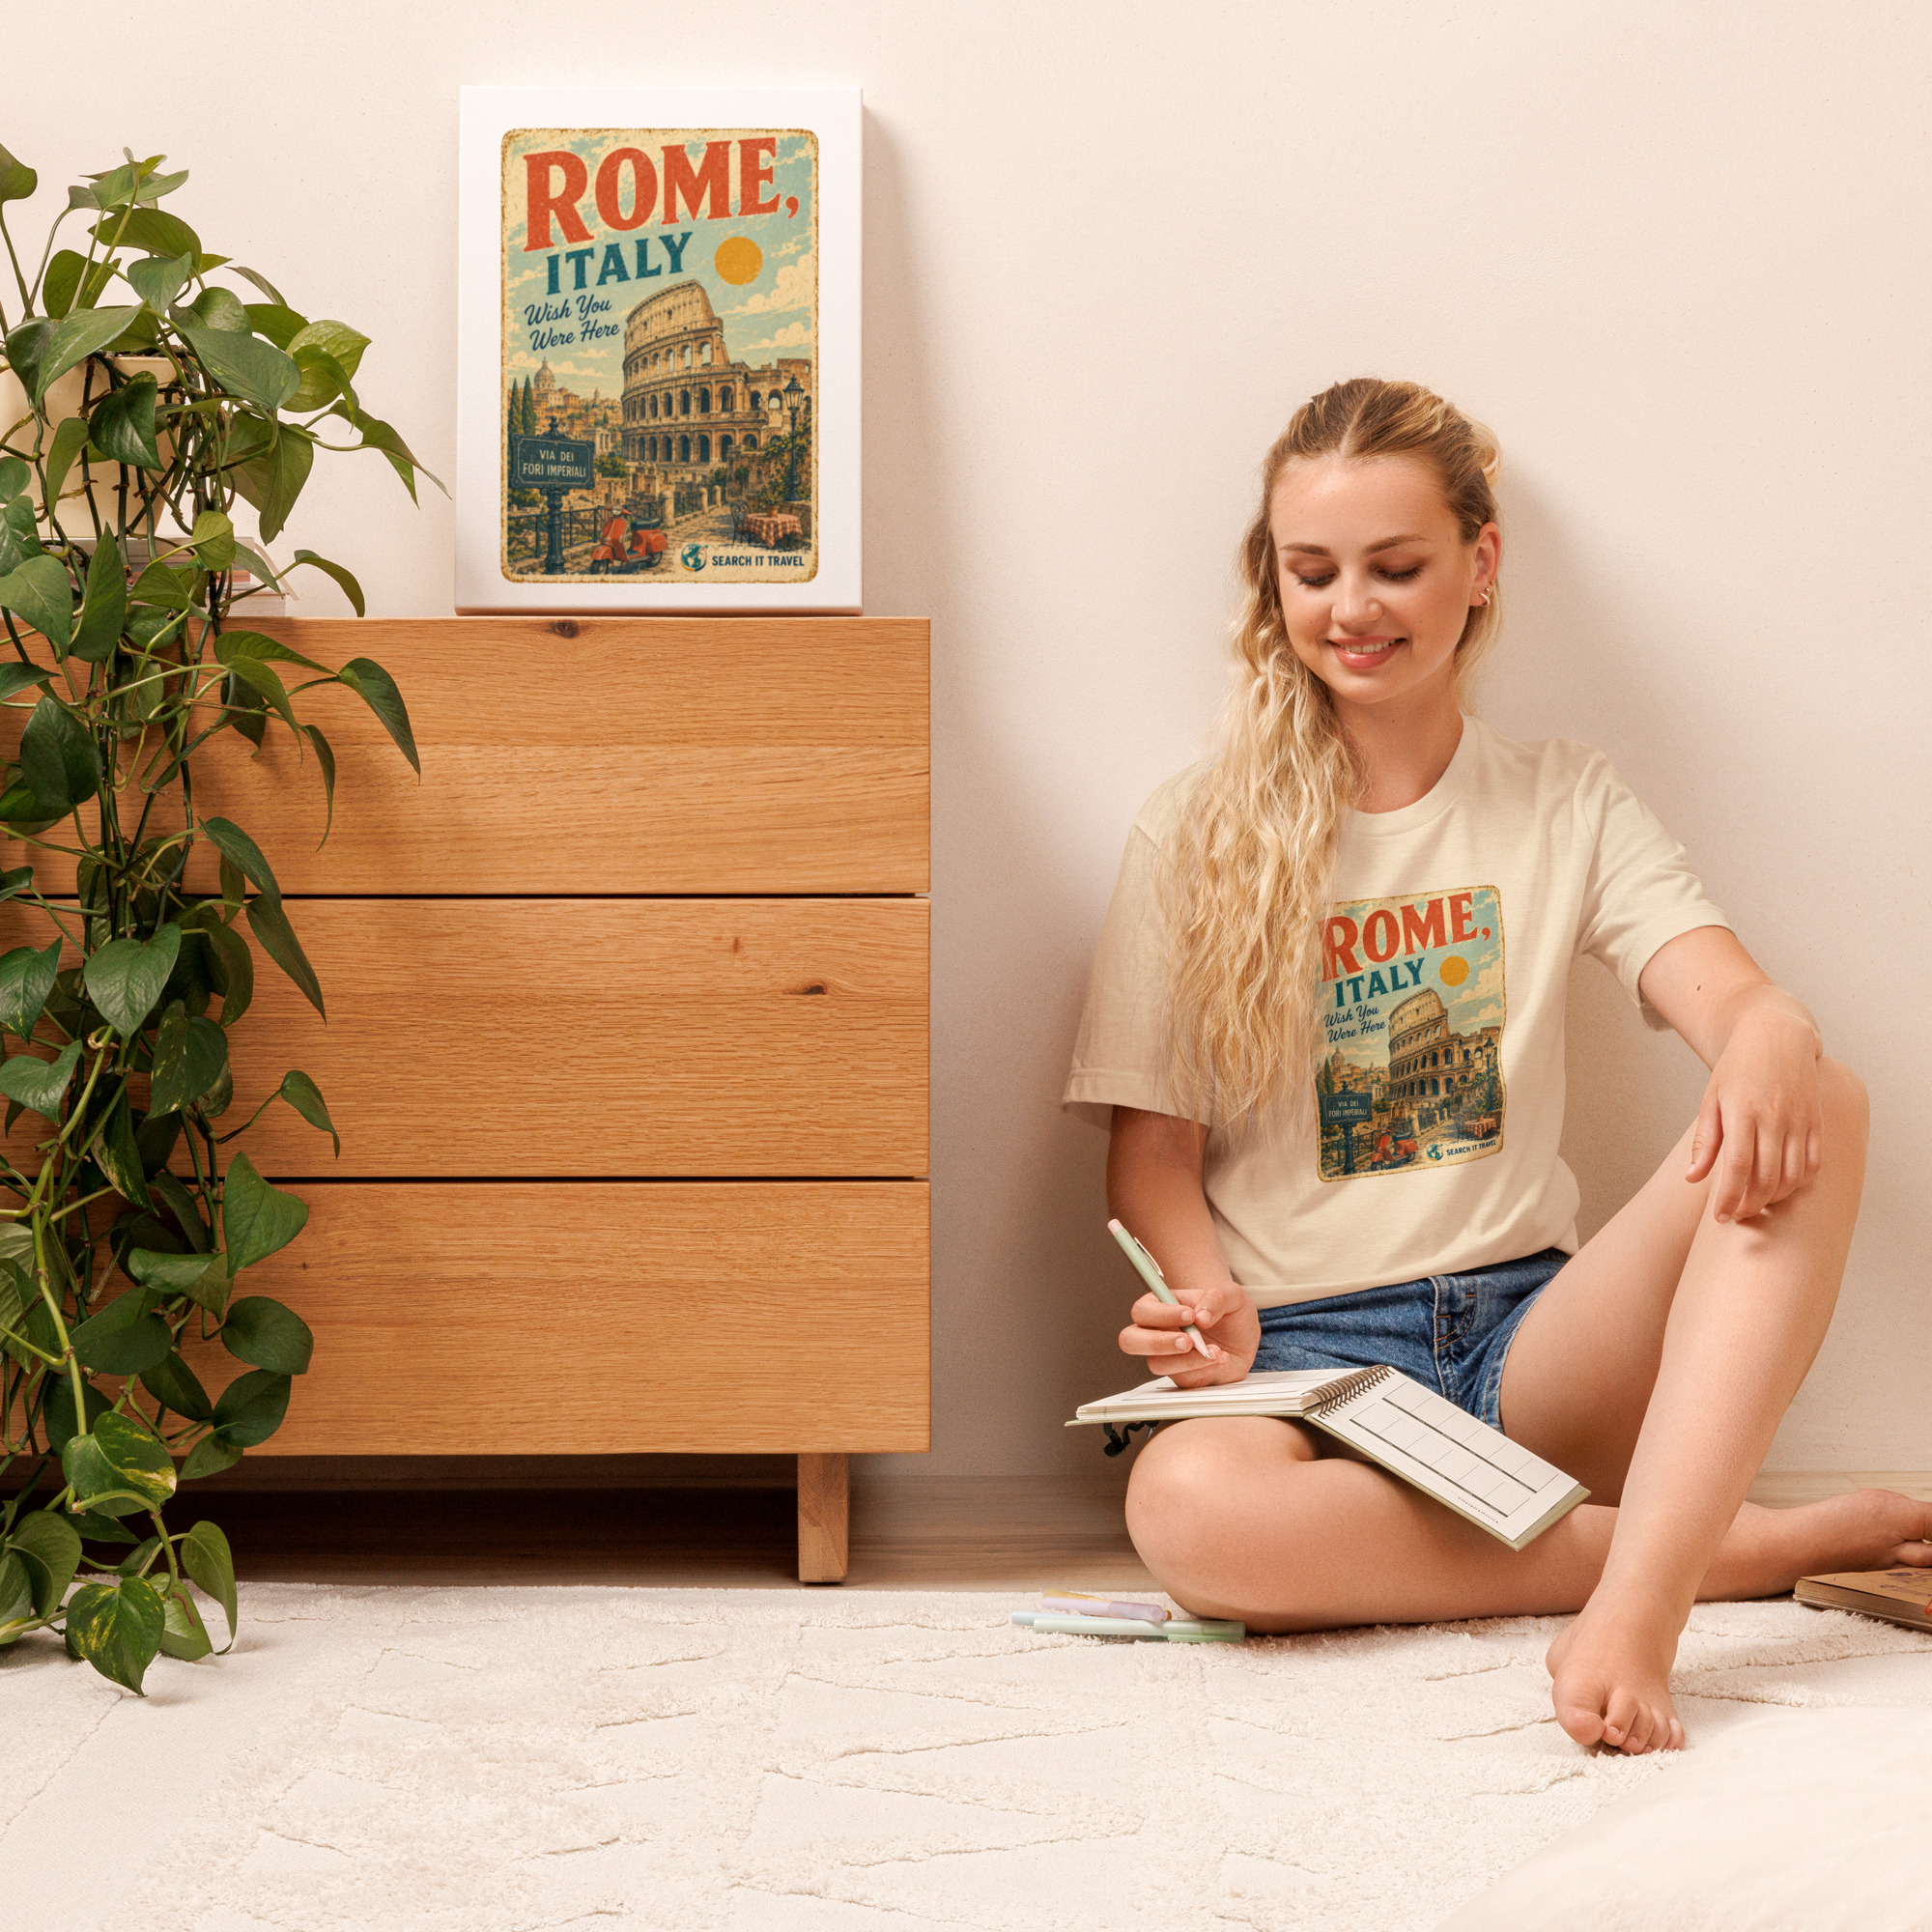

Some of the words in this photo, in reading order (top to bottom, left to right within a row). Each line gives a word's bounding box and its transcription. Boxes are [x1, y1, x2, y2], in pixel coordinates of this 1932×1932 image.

[523, 137, 800, 253] ROME,
[546, 231, 694, 296] ITALY
[525, 295, 572, 327] Wish
[576, 294, 612, 322] You
[529, 329, 576, 352] Were
[581, 320, 620, 343] Here
[539, 449, 555, 461] VIA
[560, 451, 574, 463] DEI
[523, 463, 544, 476] FORI
[547, 464, 586, 478] IMPERIALI
[712, 555, 752, 567] SEARCH
[755, 555, 765, 567] IT
[767, 555, 805, 567] TRAVEL
[1316, 892, 1492, 982] ROME,
[1334, 957, 1425, 1009] ITALY
[1323, 1009, 1354, 1028] Wish
[1355, 1004, 1379, 1023] You
[1327, 1027, 1357, 1043] Were
[1360, 1020, 1386, 1036] Here
[1328, 1110, 1342, 1119] FORI
[1446, 1146, 1471, 1156] SEARCH
[1479, 1139, 1496, 1150] TRAVEL
